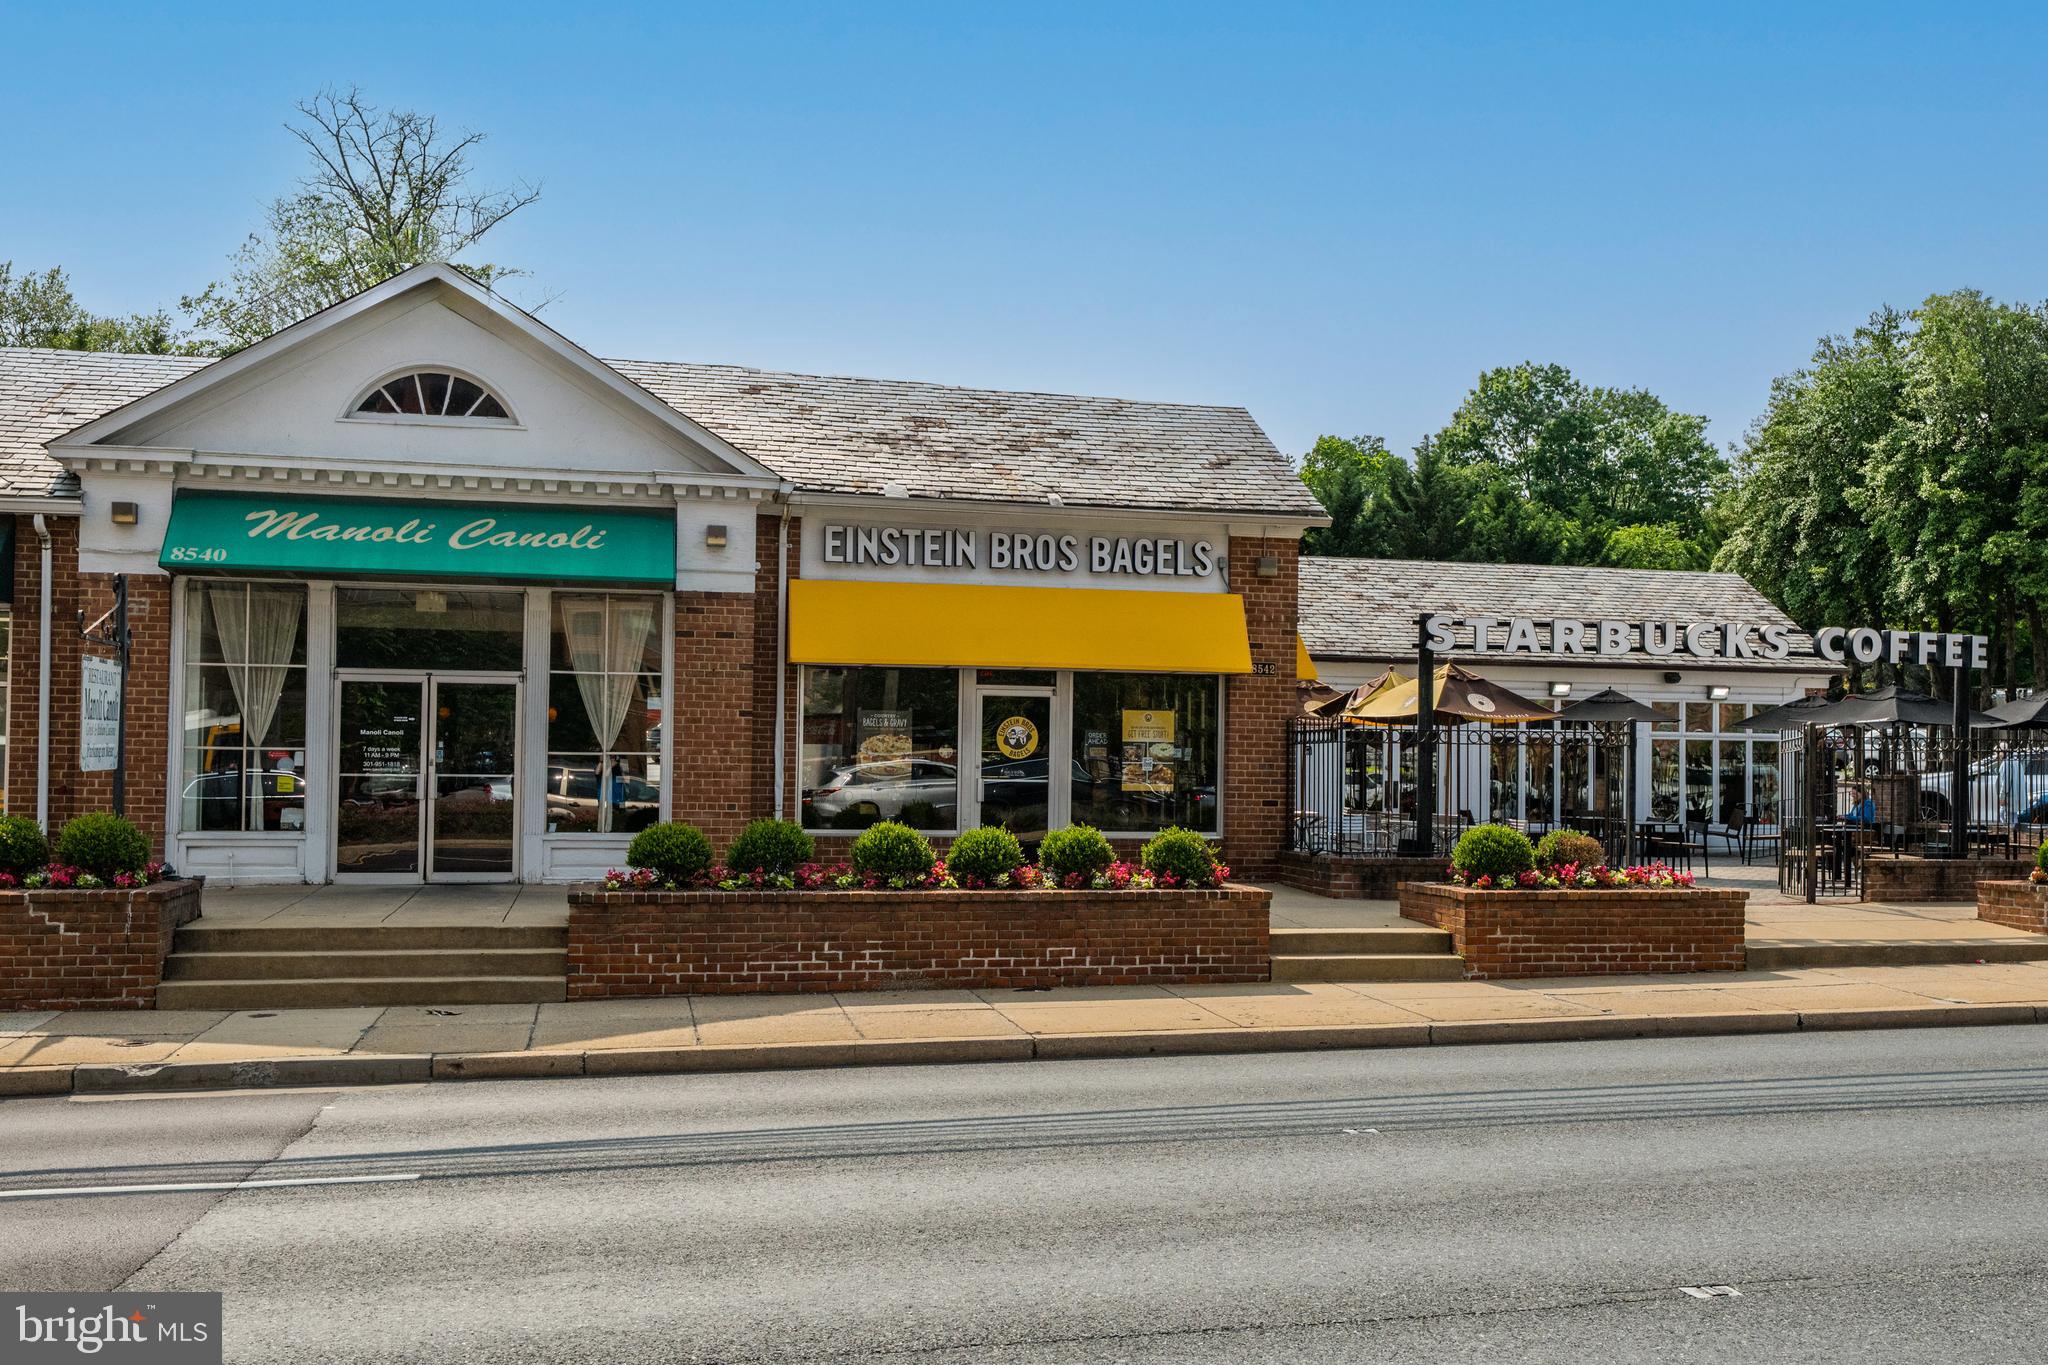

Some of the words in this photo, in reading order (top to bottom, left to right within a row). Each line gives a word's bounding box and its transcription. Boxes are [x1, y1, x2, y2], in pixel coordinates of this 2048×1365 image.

[245, 509, 433, 544] Manoli
[448, 518, 607, 551] Canoli
[169, 546, 228, 562] 8540
[824, 525, 977, 569] EINSTEIN
[990, 531, 1079, 572] BROS
[1090, 536, 1214, 577] BAGELS
[1425, 615, 1790, 660] STARBUCKS
[1813, 626, 1989, 669] COFFEE
[1252, 664, 1276, 674] 8542
[84, 688, 102, 721] Manoli
[103, 689, 119, 721] Canoli
[863, 718, 882, 727] BAGELS
[998, 718, 1020, 736] EINSTEIN
[1021, 719, 1036, 733] BROS
[1009, 748, 1031, 758] BAGELS
